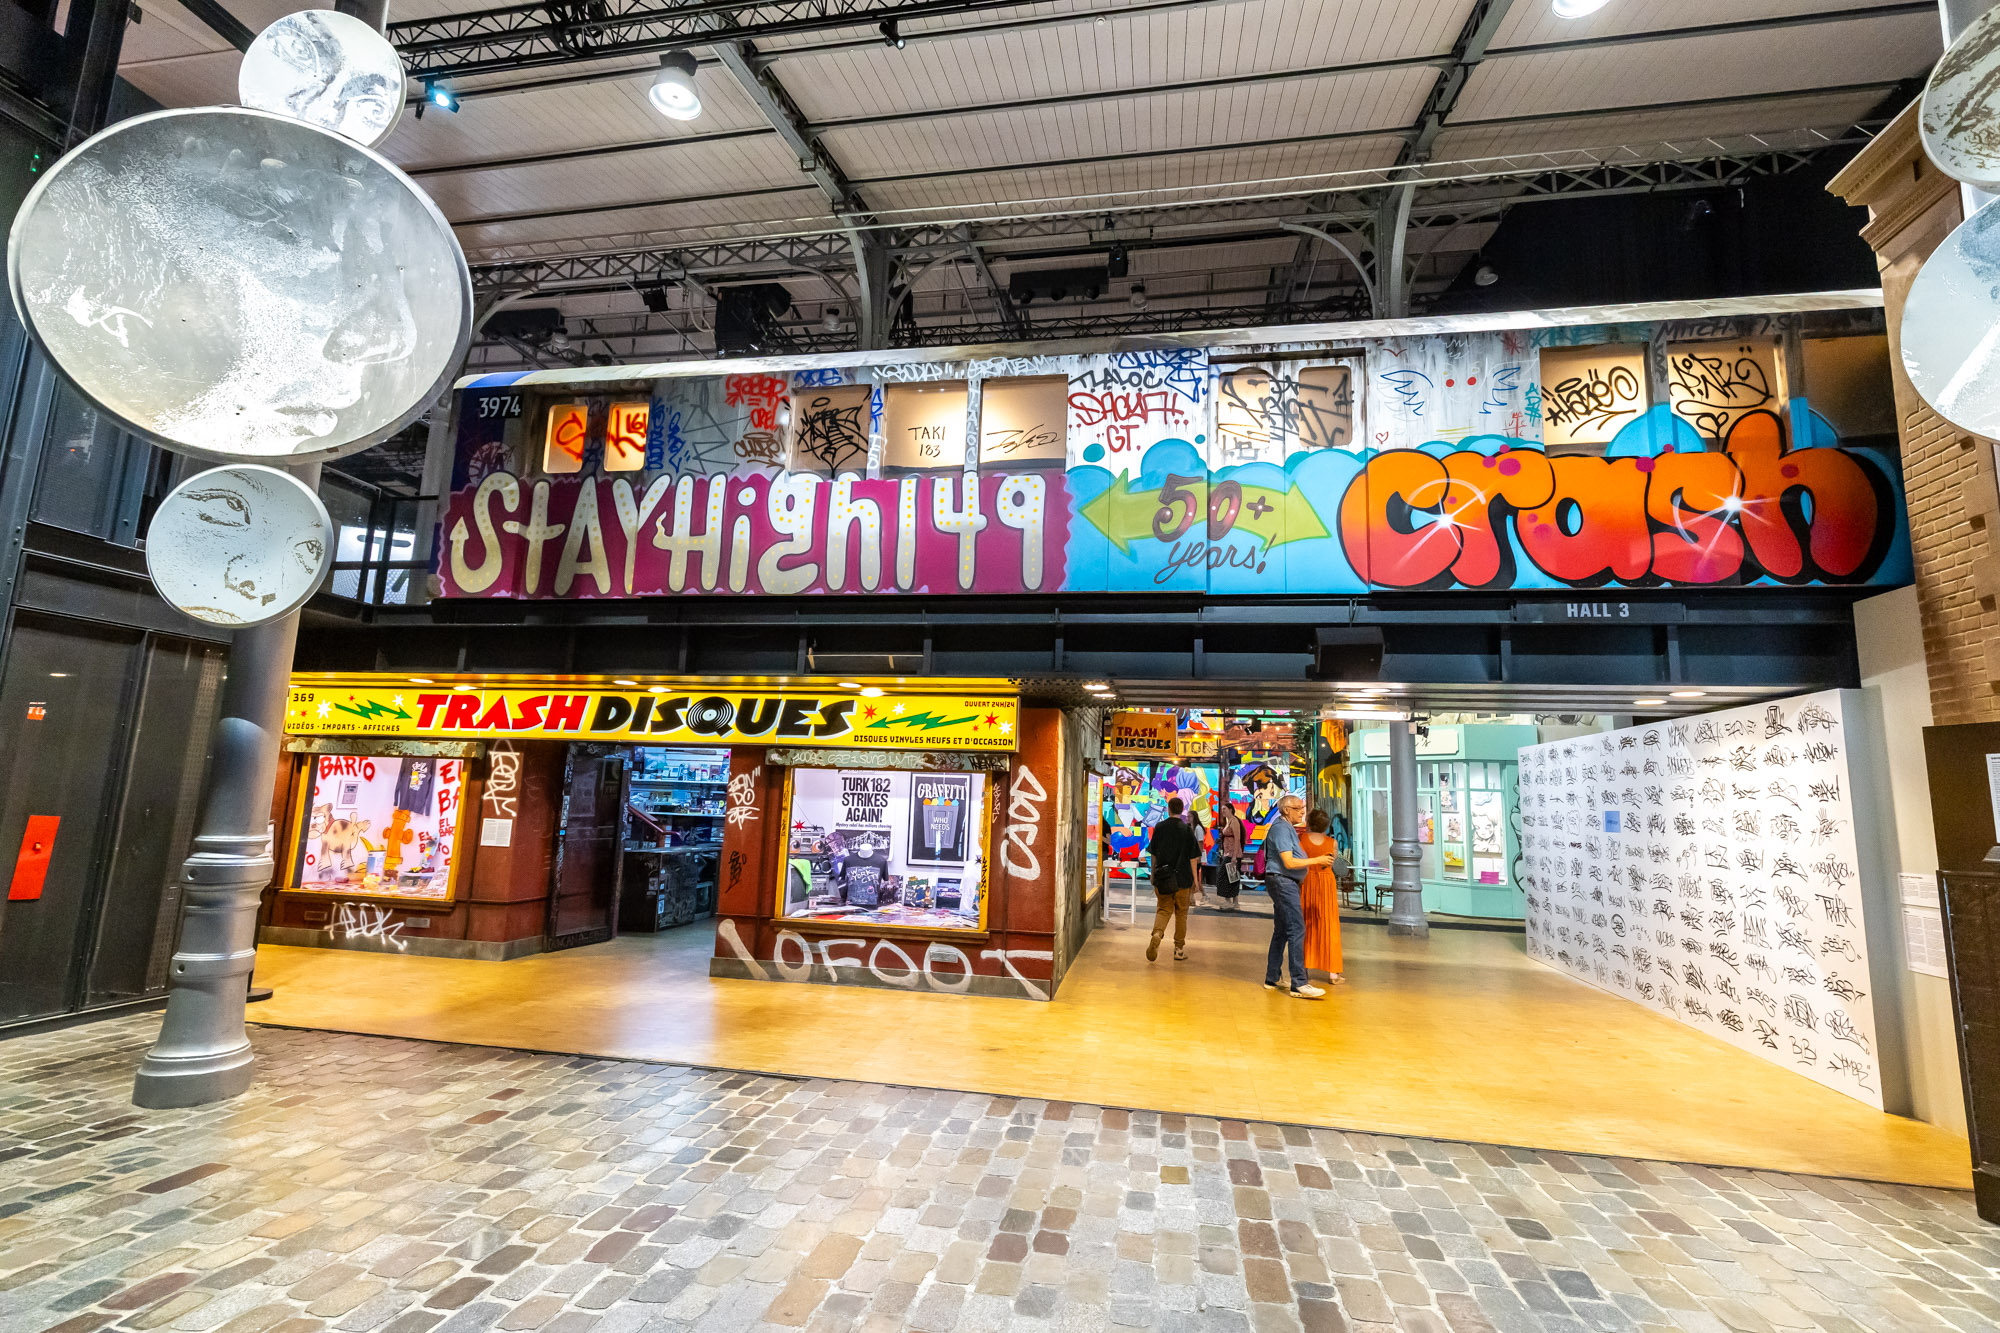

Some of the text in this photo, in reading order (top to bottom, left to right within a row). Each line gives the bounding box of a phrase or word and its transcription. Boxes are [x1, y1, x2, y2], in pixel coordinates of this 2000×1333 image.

[480, 395, 521, 418] 3974
[908, 426, 946, 441] TAKI
[919, 445, 941, 457] 183
[1152, 473, 1274, 543] 50+
[1154, 533, 1277, 584] years!
[1566, 603, 1630, 618] HALL 3
[293, 693, 315, 702] 369
[964, 700, 1015, 709] OUVERT 24H/24
[416, 694, 857, 740] TRASH DISQUES
[287, 721, 401, 732] VIDÉOS IMPORTS AFFICHES
[1117, 726, 1157, 737] TRASH
[854, 735, 1014, 746] DISQUES VINYLES NEUFS ET D'OCCASION
[1116, 737, 1171, 750] DISQUES
[320, 756, 376, 782] BARTO
[842, 777, 891, 793] TURK 182
[917, 783, 965, 800] GRAFFITI
[841, 792, 889, 808] STRIKES
[845, 808, 883, 823] AGAIN!
